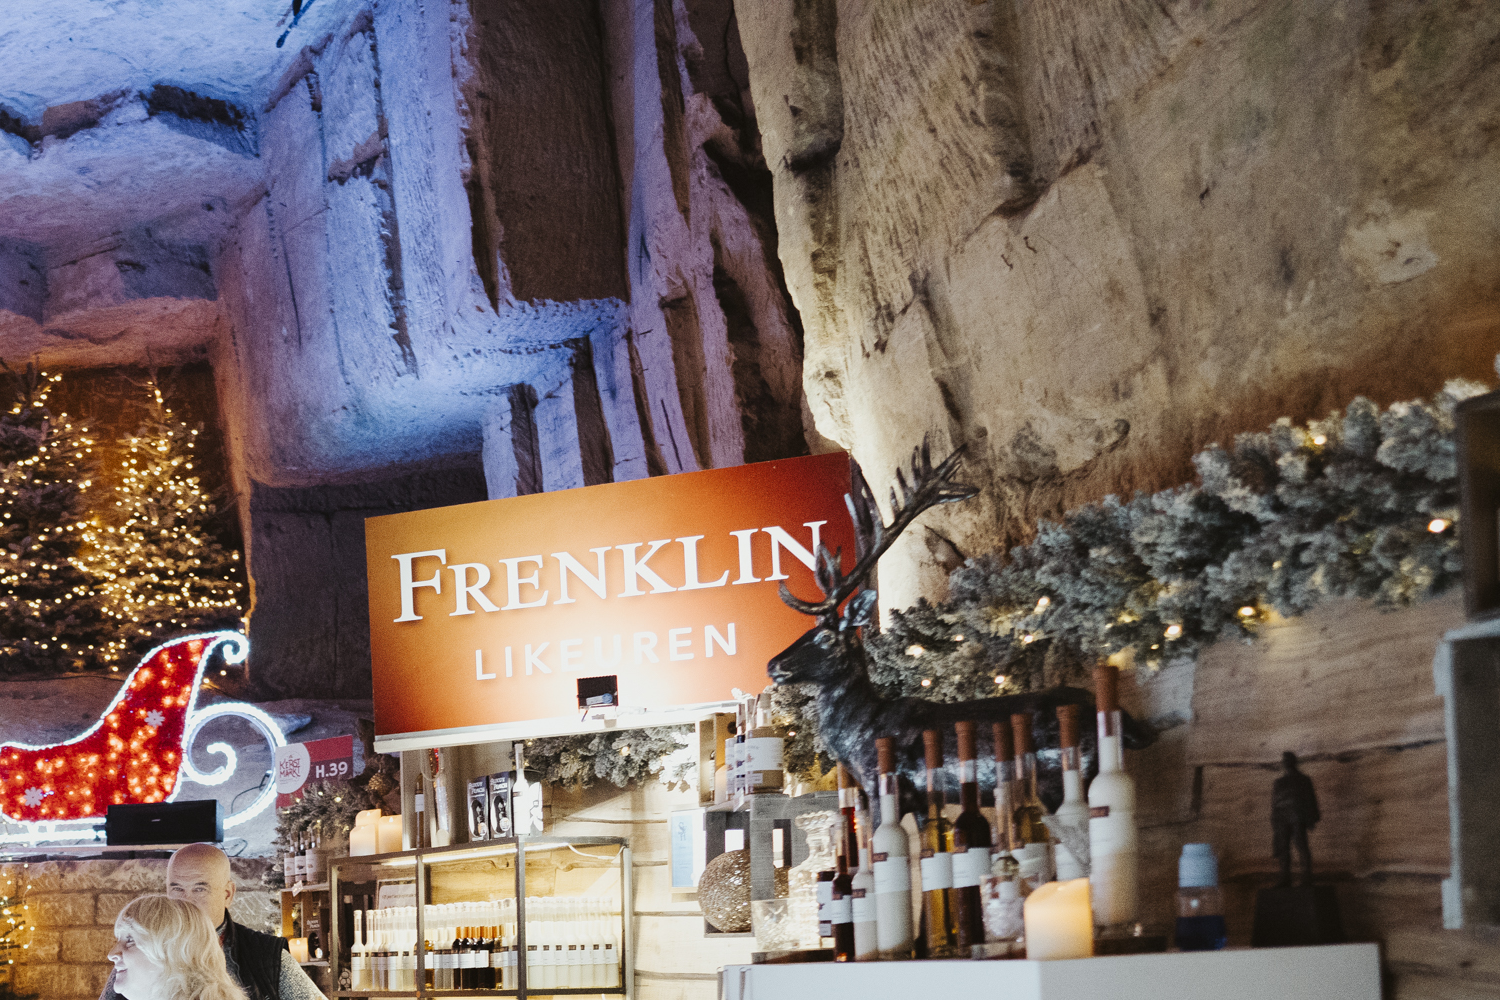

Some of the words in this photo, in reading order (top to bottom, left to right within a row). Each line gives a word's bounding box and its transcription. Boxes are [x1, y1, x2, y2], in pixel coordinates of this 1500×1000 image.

[390, 520, 828, 623] FRENKLIN
[474, 622, 737, 681] LIKEUREN
[315, 761, 348, 778] H.39
